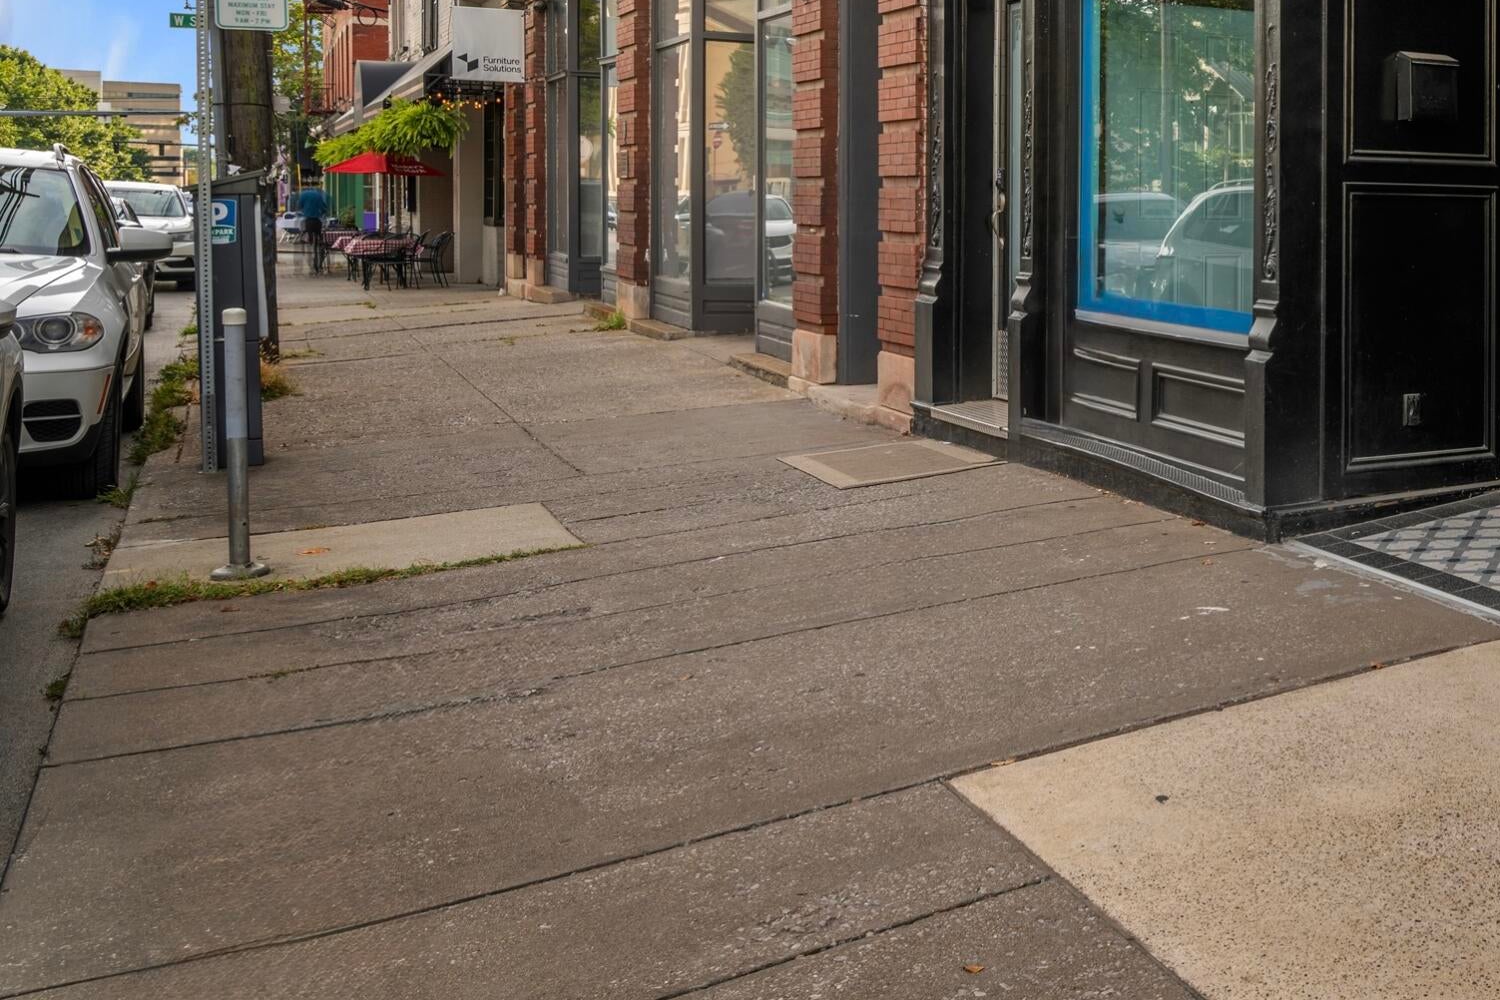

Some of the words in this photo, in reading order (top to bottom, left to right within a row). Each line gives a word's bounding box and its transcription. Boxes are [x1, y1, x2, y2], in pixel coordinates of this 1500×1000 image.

[174, 15, 184, 26] W
[483, 56, 520, 65] Furniture
[483, 64, 522, 73] Solutions
